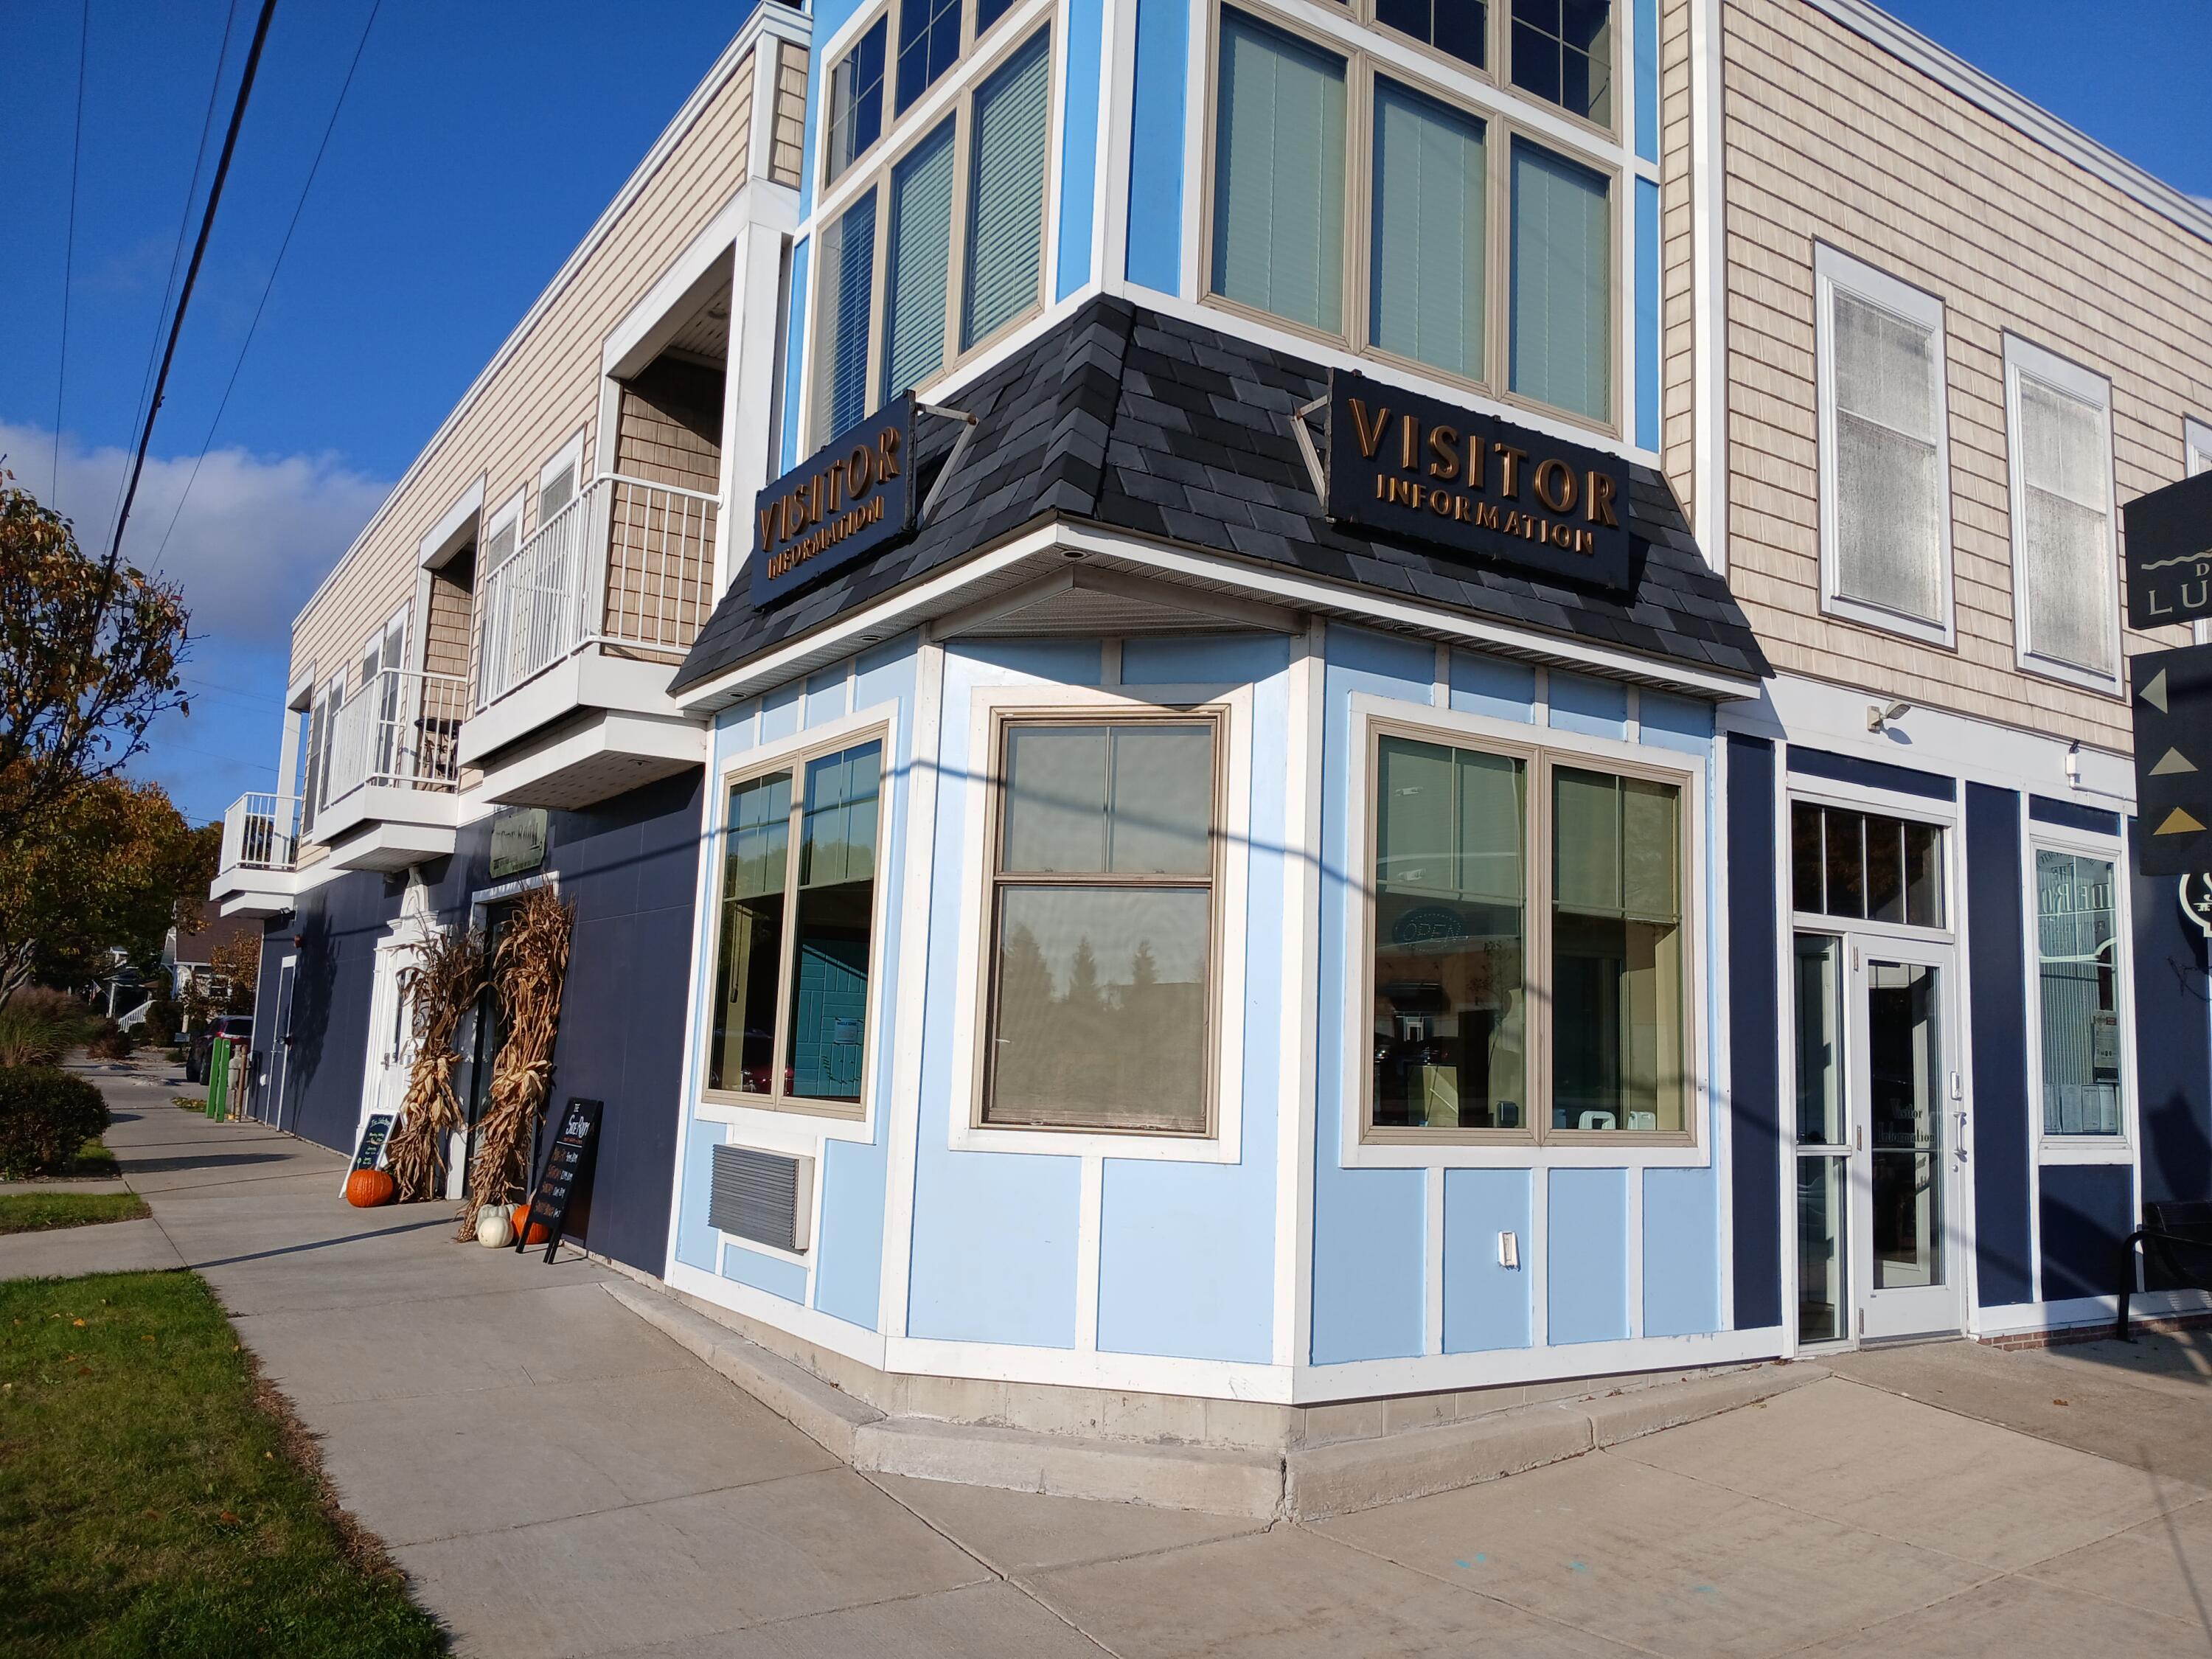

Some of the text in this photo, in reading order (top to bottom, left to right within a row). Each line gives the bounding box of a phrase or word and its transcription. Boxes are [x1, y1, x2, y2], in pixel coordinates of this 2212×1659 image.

[759, 426, 902, 552] VISITOR
[1349, 398, 1618, 526] VISITOR
[767, 495, 885, 580] INFORMATION
[1376, 474, 1594, 555] INFORMATION
[1403, 922, 1460, 943] OPEN
[1877, 1121, 1935, 1142] Information
[1889, 1098, 1923, 1119] Visitor
